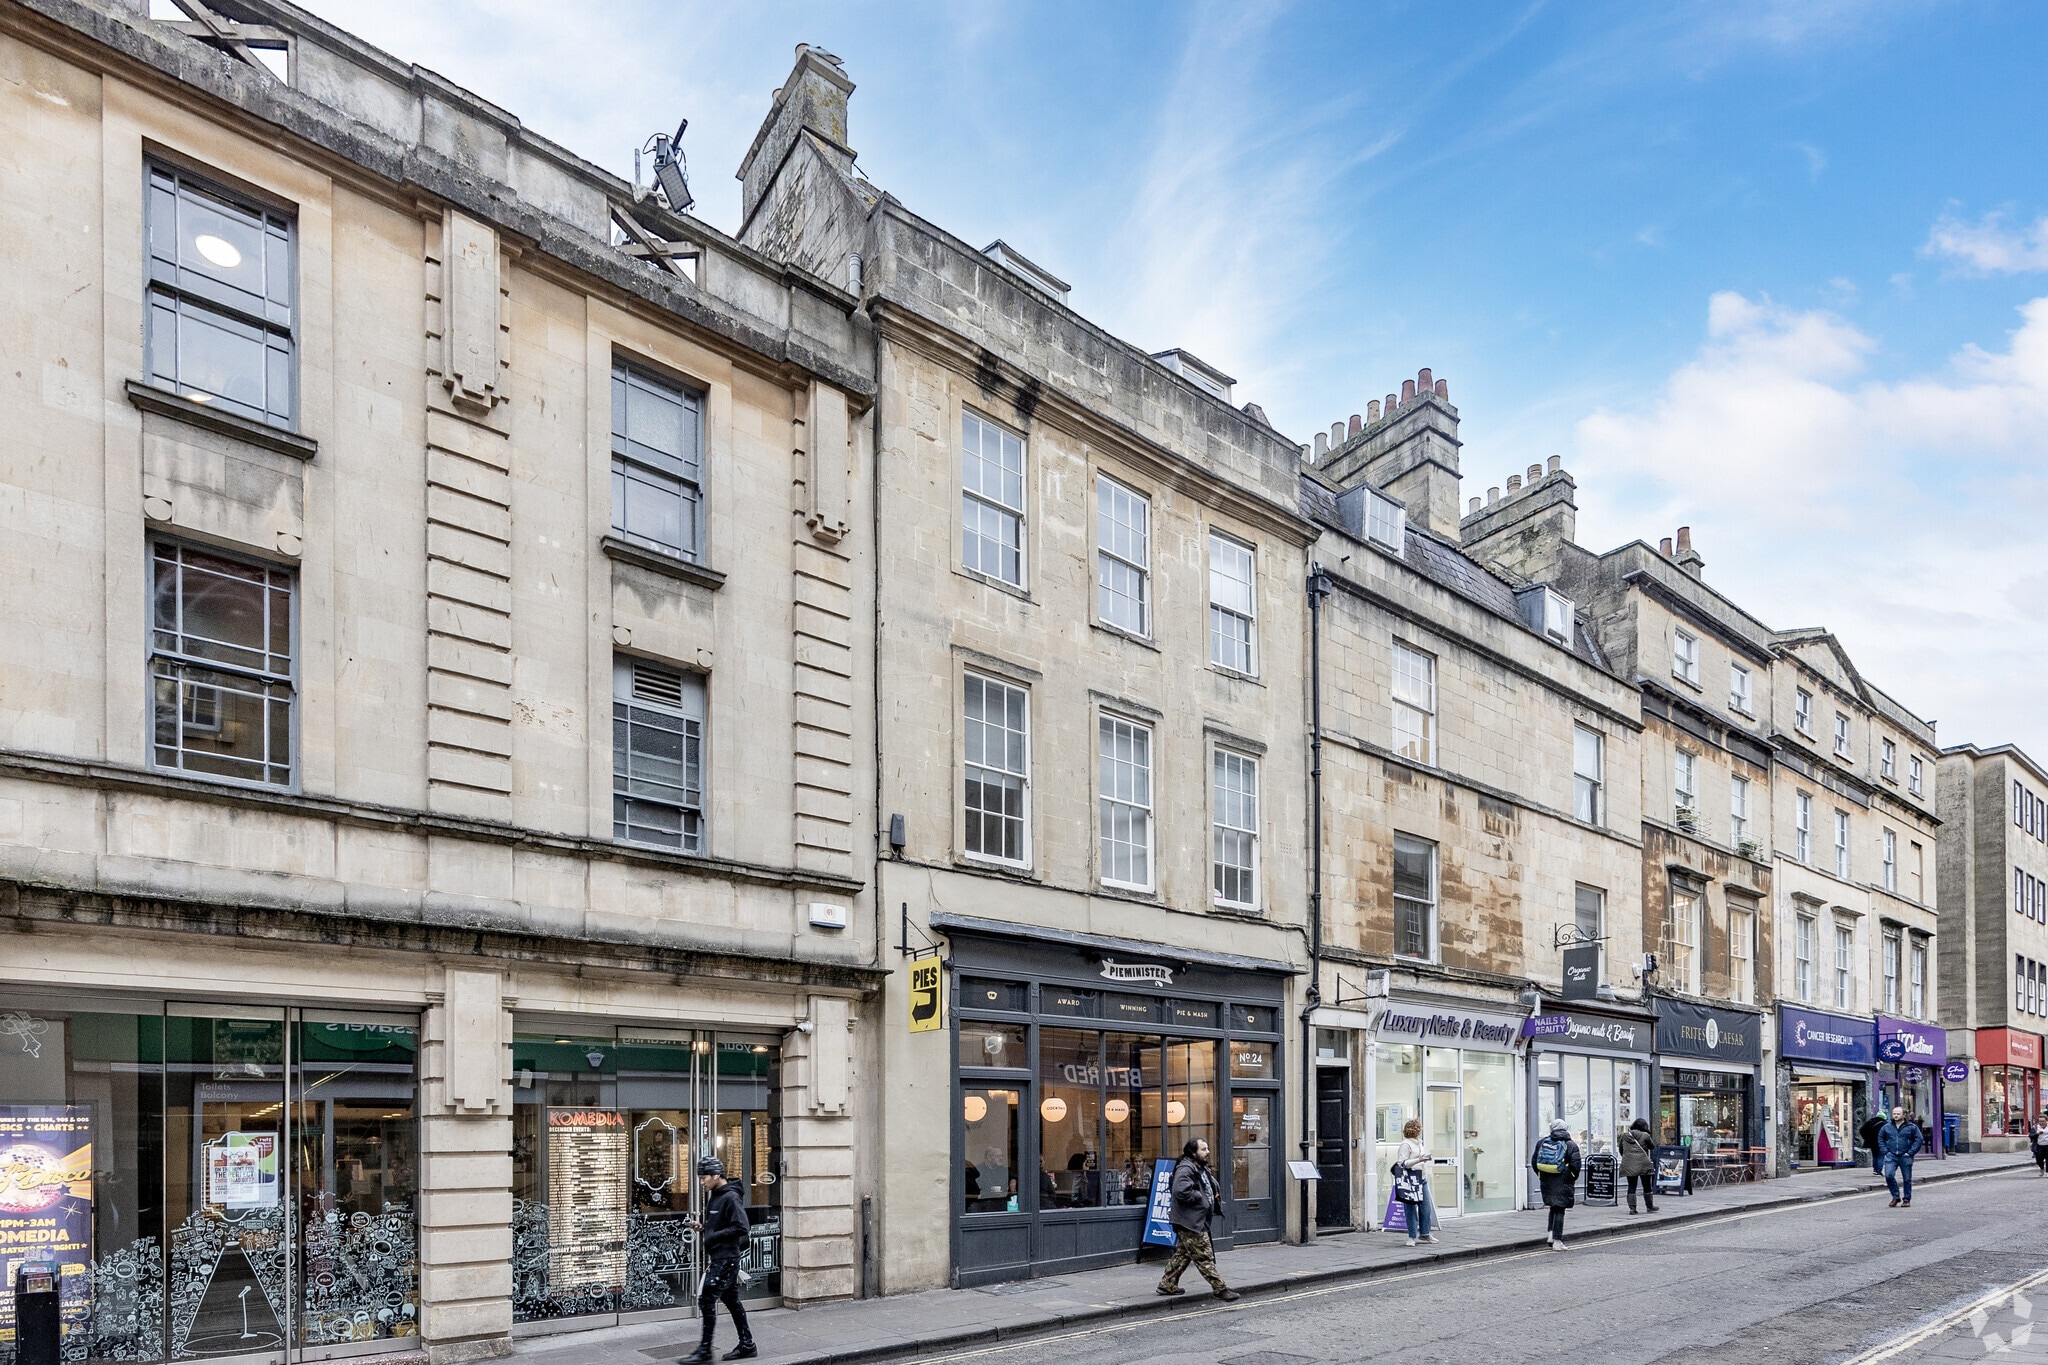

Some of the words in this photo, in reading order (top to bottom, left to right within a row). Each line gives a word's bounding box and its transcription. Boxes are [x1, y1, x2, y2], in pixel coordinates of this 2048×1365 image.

[1109, 966, 1166, 979] PIEMINISTER
[1567, 966, 1592, 977] Organic
[912, 966, 937, 990] PIES
[1057, 999, 1080, 1007] AWARD
[1119, 1004, 1147, 1013] WINNING
[1534, 1016, 1558, 1026] NAILS
[1560, 1015, 1567, 1023] &
[1460, 1018, 1472, 1038] &
[1472, 1020, 1516, 1046] Beauty
[1535, 1024, 1566, 1034] BEAUTY
[1564, 1016, 1592, 1040] Organic
[1606, 1024, 1613, 1042] &
[1613, 1023, 1636, 1048] Beauty
[1681, 1025, 1706, 1041] FRITES
[1718, 1030, 1744, 1047] CAESAR
[1807, 1030, 1825, 1042] CANCER
[1825, 1032, 1847, 1045] RESEARCH
[1847, 1036, 1853, 1046] UK
[1252, 1053, 1262, 1063] 24
[1947, 1065, 1964, 1073] Cha
[201, 1083, 231, 1091] Toilets
[201, 1091, 239, 1099] Balcony
[549, 1111, 625, 1126] KOMEDIA
[33, 1123, 75, 1131] CHARTS
[214, 1171, 226, 1179] THE
[1154, 1191, 1172, 1207] PIE
[1152, 1205, 1171, 1220] MAS
[388, 1220, 399, 1230] M
